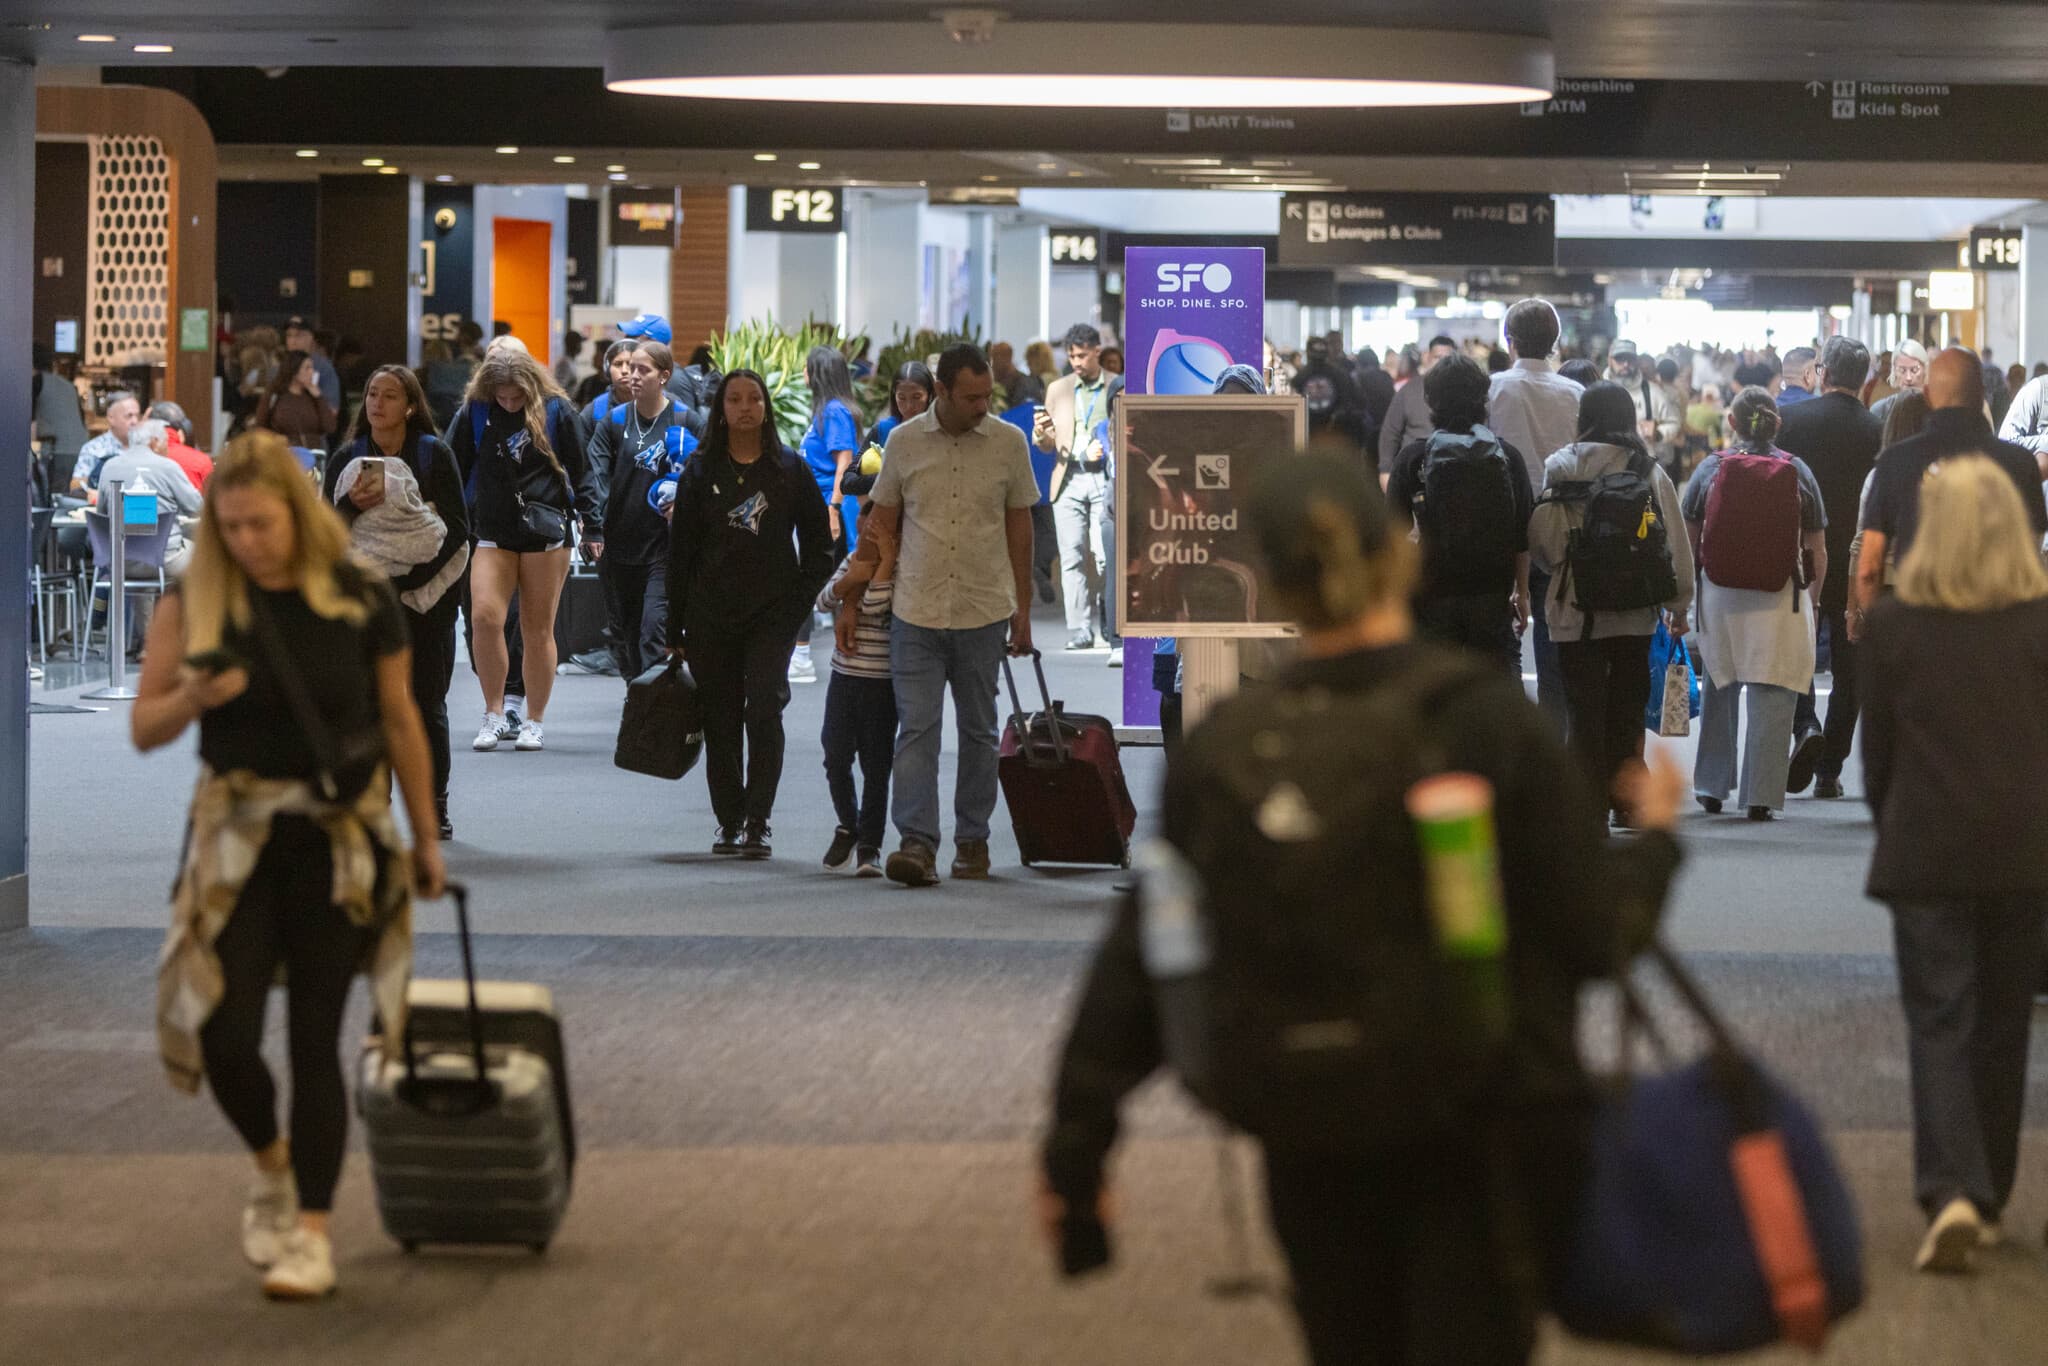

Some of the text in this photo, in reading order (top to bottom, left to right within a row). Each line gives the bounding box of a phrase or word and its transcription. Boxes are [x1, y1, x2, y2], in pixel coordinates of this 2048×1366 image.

[1860, 82, 1951, 96] Restrooms
[1547, 99, 1587, 113] ATM
[1860, 102, 1941, 118] Kids Spot
[1194, 115, 1296, 129] BART Trains
[771, 189, 834, 222] F12
[1344, 203, 1385, 219] Gates
[1329, 223, 1387, 242] Lounges
[1403, 224, 1443, 240] Clubs
[1052, 235, 1097, 260] F14
[1977, 238, 2021, 264] F13
[1156, 263, 1232, 293] SFO
[1140, 298, 1248, 309] SHOP. DINE. SFO.
[1150, 508, 1238, 531] United
[1149, 541, 1209, 564] Club
